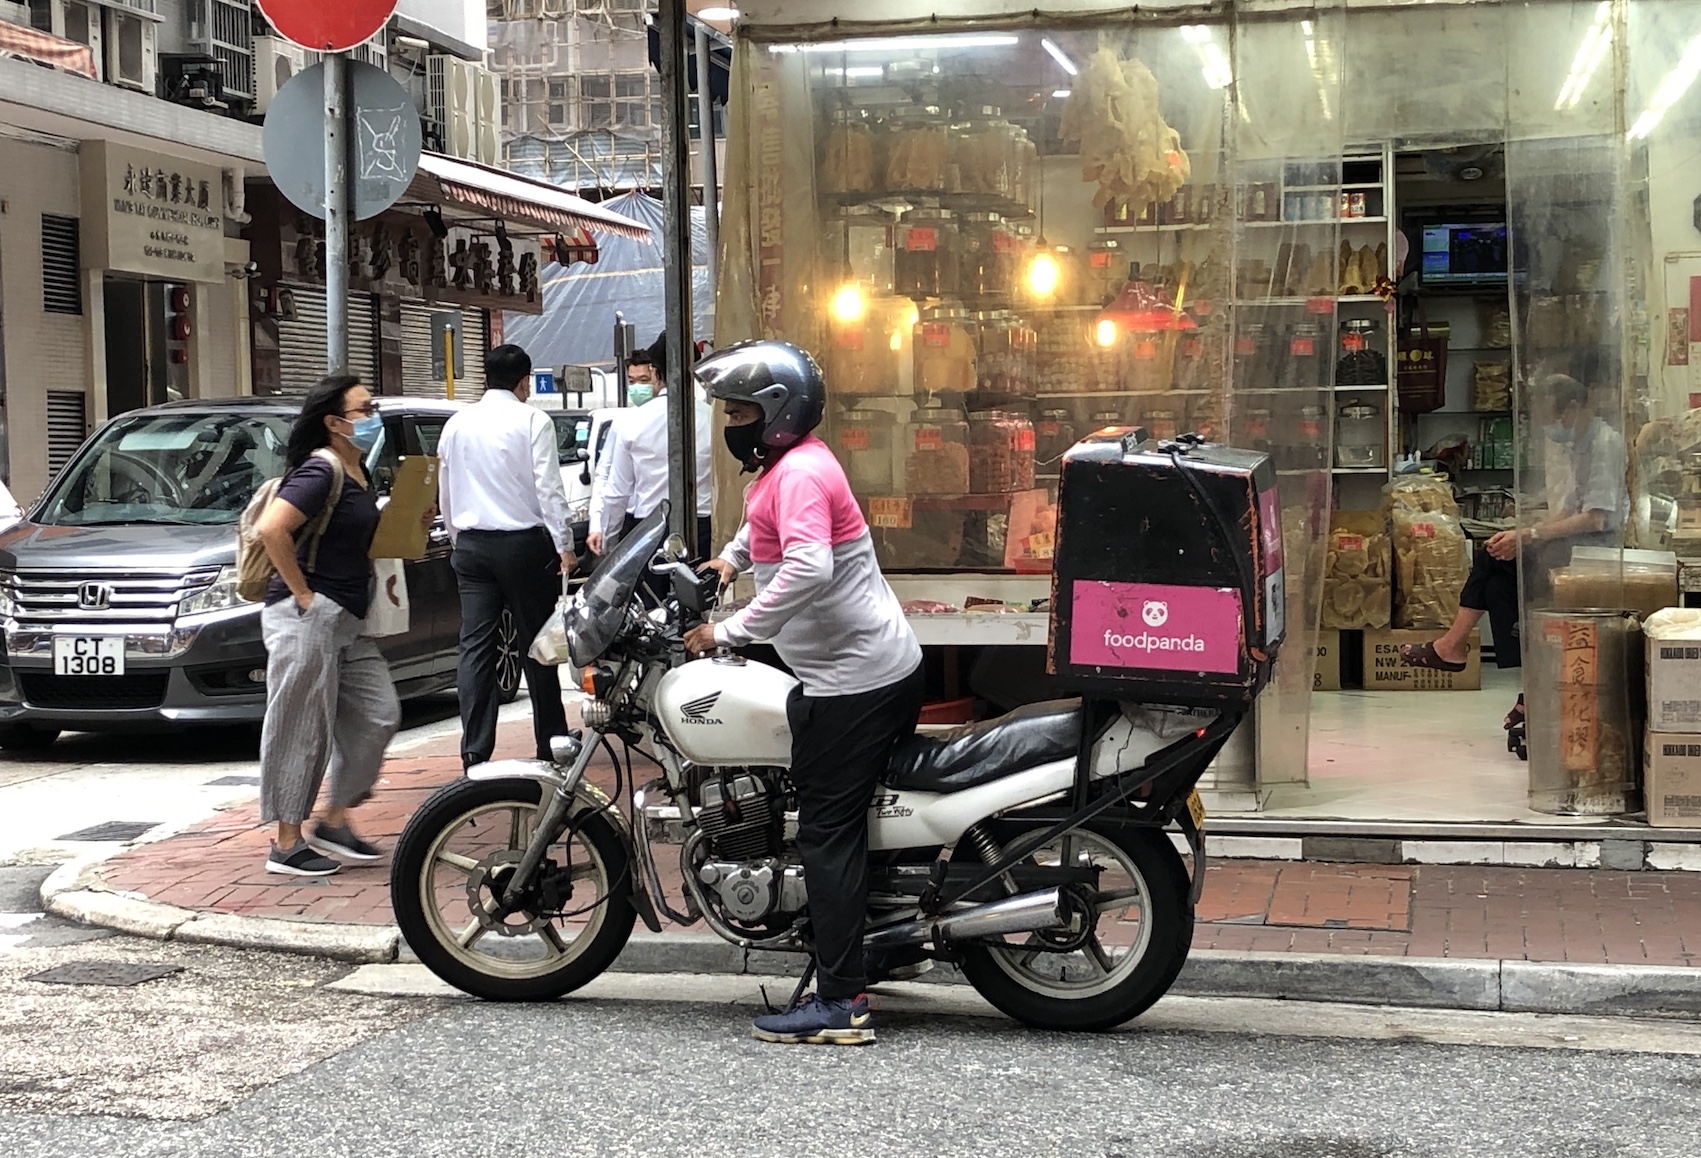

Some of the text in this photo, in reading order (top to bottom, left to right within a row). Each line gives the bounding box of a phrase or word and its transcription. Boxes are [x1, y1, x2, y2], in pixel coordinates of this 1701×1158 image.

[75, 637, 104, 656] CT
[1103, 629, 1205, 653] foodpanda
[63, 656, 115, 674] 1308
[1375, 657, 1397, 667] NW
[681, 717, 724, 725] HONDA
[876, 806, 915, 818] Two Fifty
